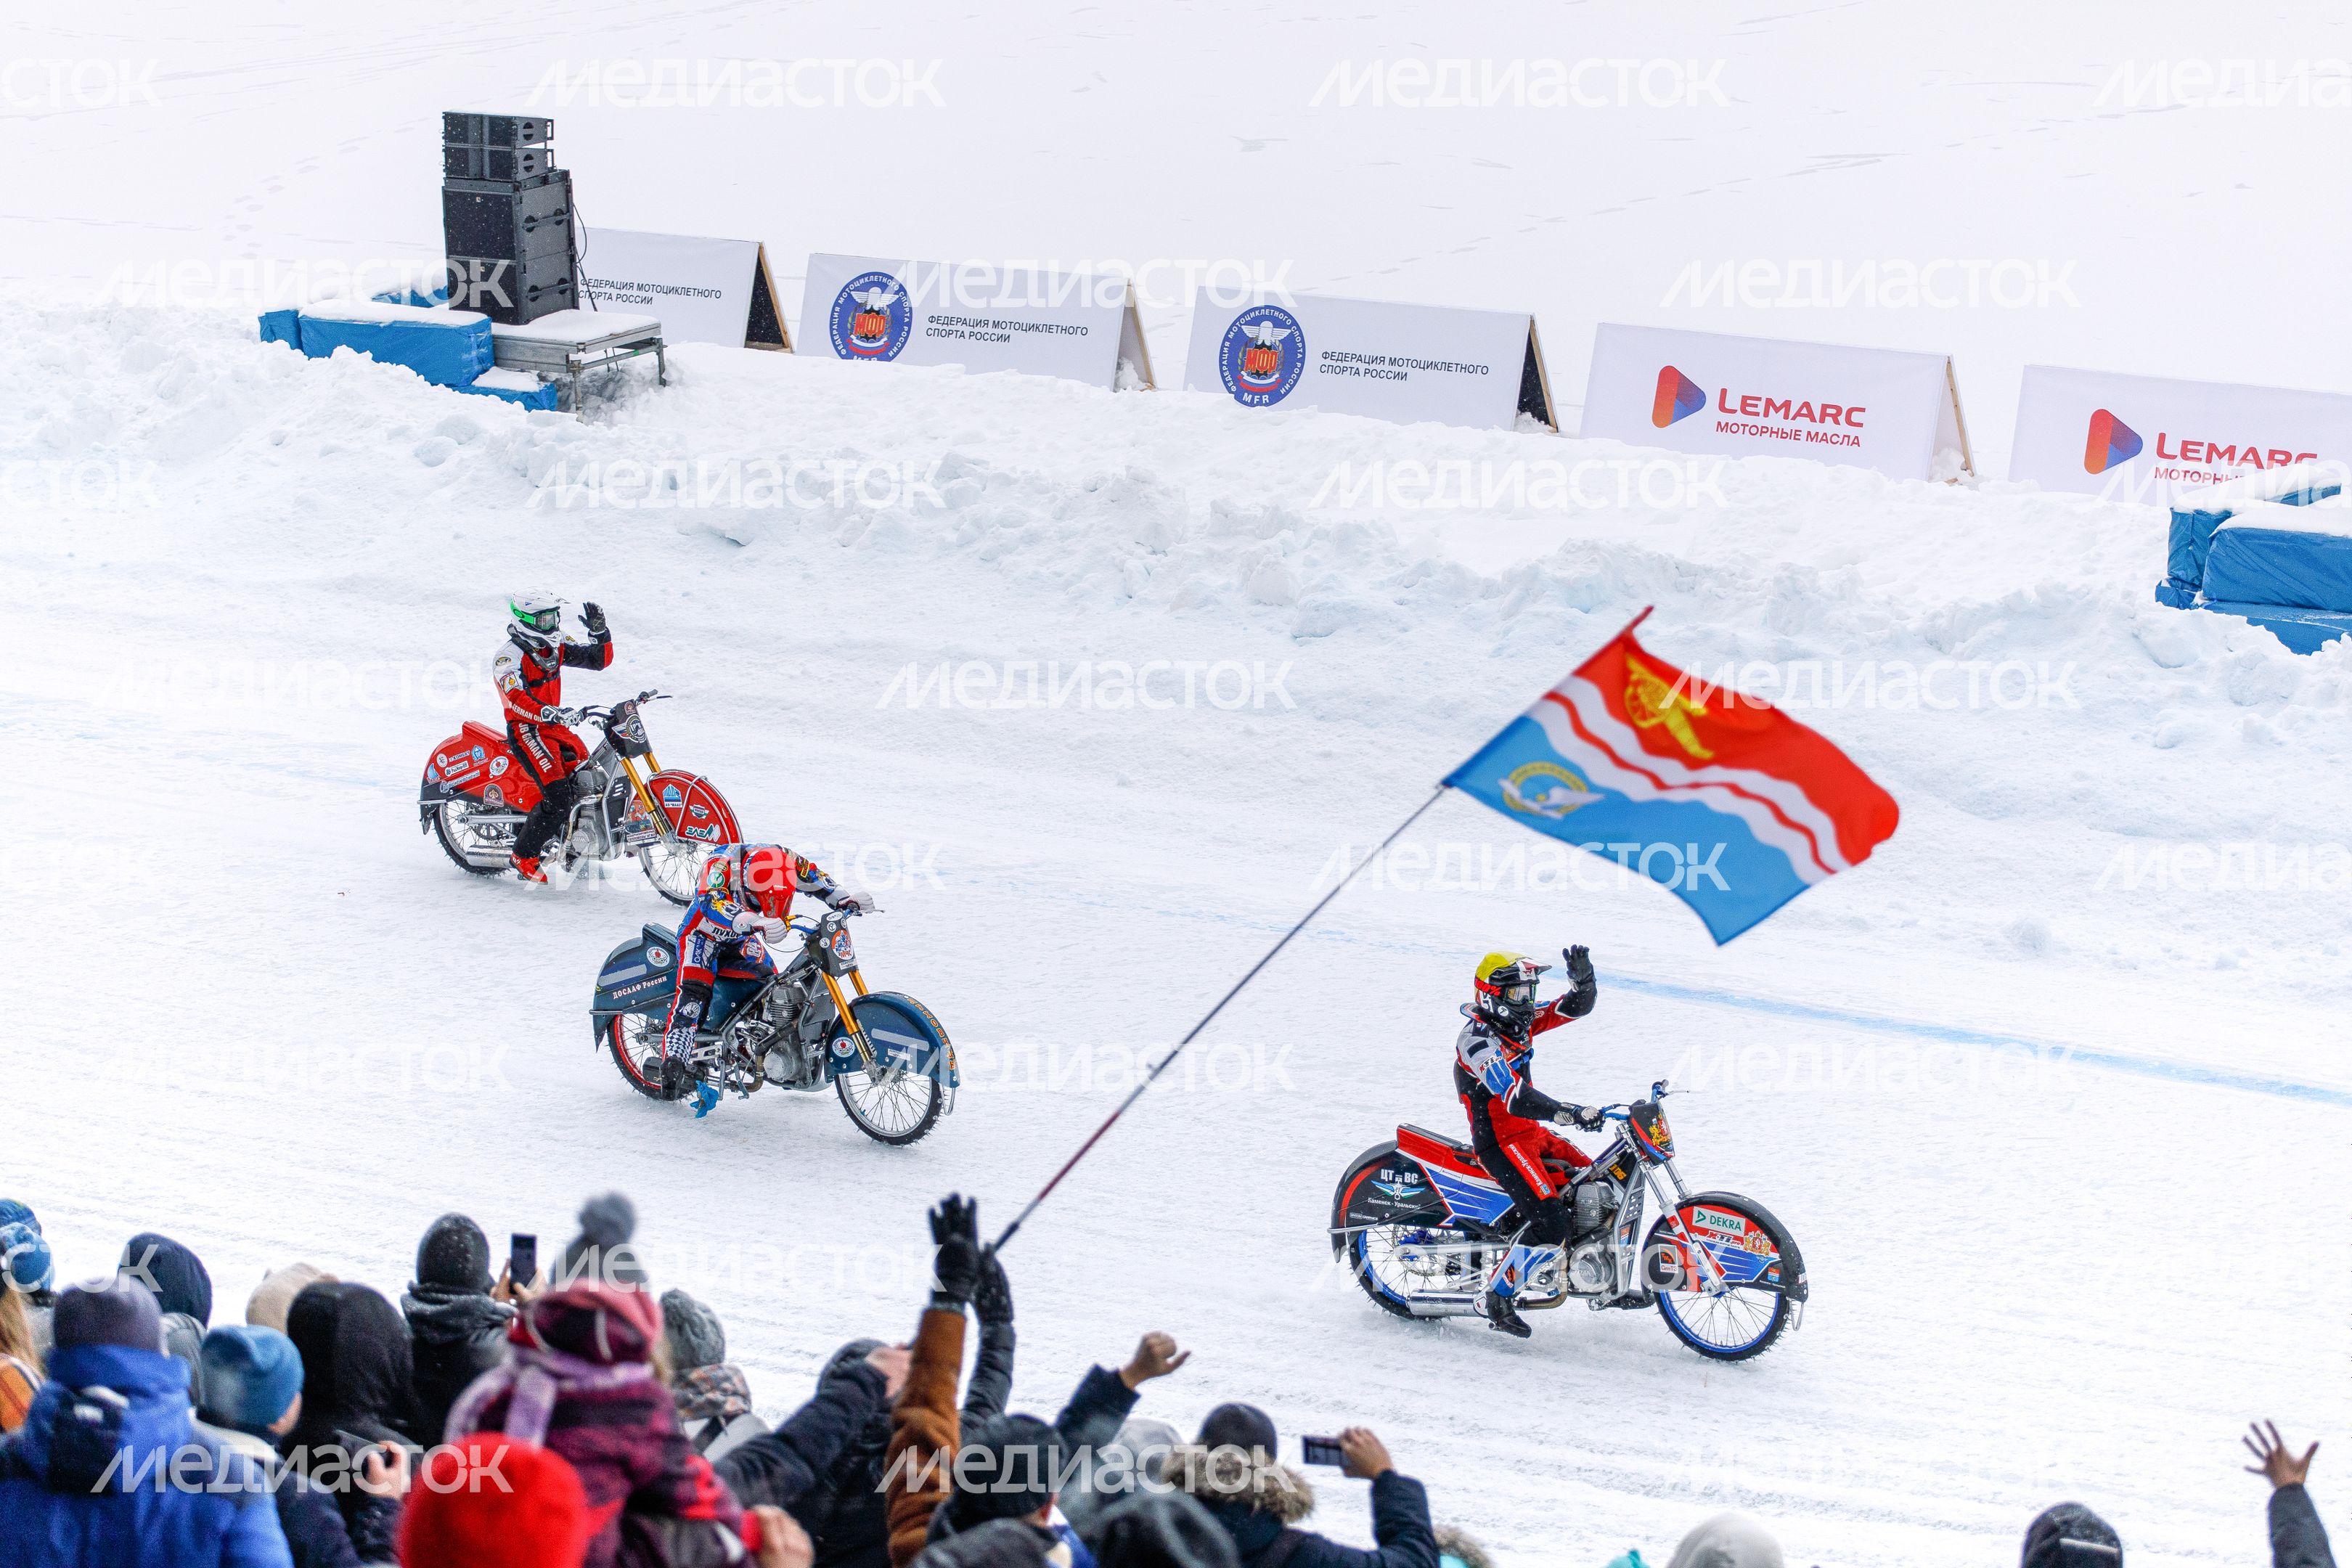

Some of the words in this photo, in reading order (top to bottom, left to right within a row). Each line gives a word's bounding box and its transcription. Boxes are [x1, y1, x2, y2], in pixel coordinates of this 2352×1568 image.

[579, 290, 613, 302] СПОРТА
[616, 293, 653, 305] РОССИИ
[581, 279, 634, 291] ФЕДЕРАЦИЯ
[637, 283, 722, 299] МОТОЦИКЛЕТНОГО
[838, 275, 900, 304] МОТОЦИКЛЕТНОГО
[899, 291, 910, 323] СПОРТА
[832, 306, 846, 355] ФЕДЕРАЦИЯ
[853, 312, 888, 338] МФР
[926, 327, 965, 340] СПОРТА
[968, 332, 1010, 343] РОССИИ
[928, 315, 989, 329] ФЕДЕРАЦИЯ
[992, 320, 1088, 336] МОТОЦИКЛЕТНОГО
[1228, 309, 1292, 339] МОТОЦИКЛЕТНОГО
[888, 326, 908, 357] РОССИИ
[1291, 325, 1303, 359] СПОРТА
[1222, 342, 1237, 392] ФЕДЕРАЦИЯ
[1244, 348, 1278, 374] МФР
[1319, 364, 1360, 377] СПОРТА
[1363, 369, 1408, 381] РОССИИ
[1321, 351, 1386, 366] ФЕДЕРАЦИЯ
[1388, 356, 1489, 375] МОТОЦИКЛЕТНОГО
[1280, 362, 1301, 394] РОССИИ
[1242, 392, 1270, 404] MFR
[1718, 388, 1866, 428] LEMARC
[1715, 421, 1802, 441] МОТОРНЫЕ
[1805, 430, 1861, 447] МАСЛА
[2154, 467, 2245, 485] МОТОРН
[539, 757, 552, 772] OIL
[711, 926, 738, 939] ПУХО
[613, 981, 642, 1000] ДОСААФ
[643, 976, 667, 989] России
[1381, 1169, 1394, 1182] ЦТ
[1404, 1172, 1418, 1184] ВС
[1609, 1164, 1627, 1180] 106
[1710, 1212, 1742, 1231] DEKRA
